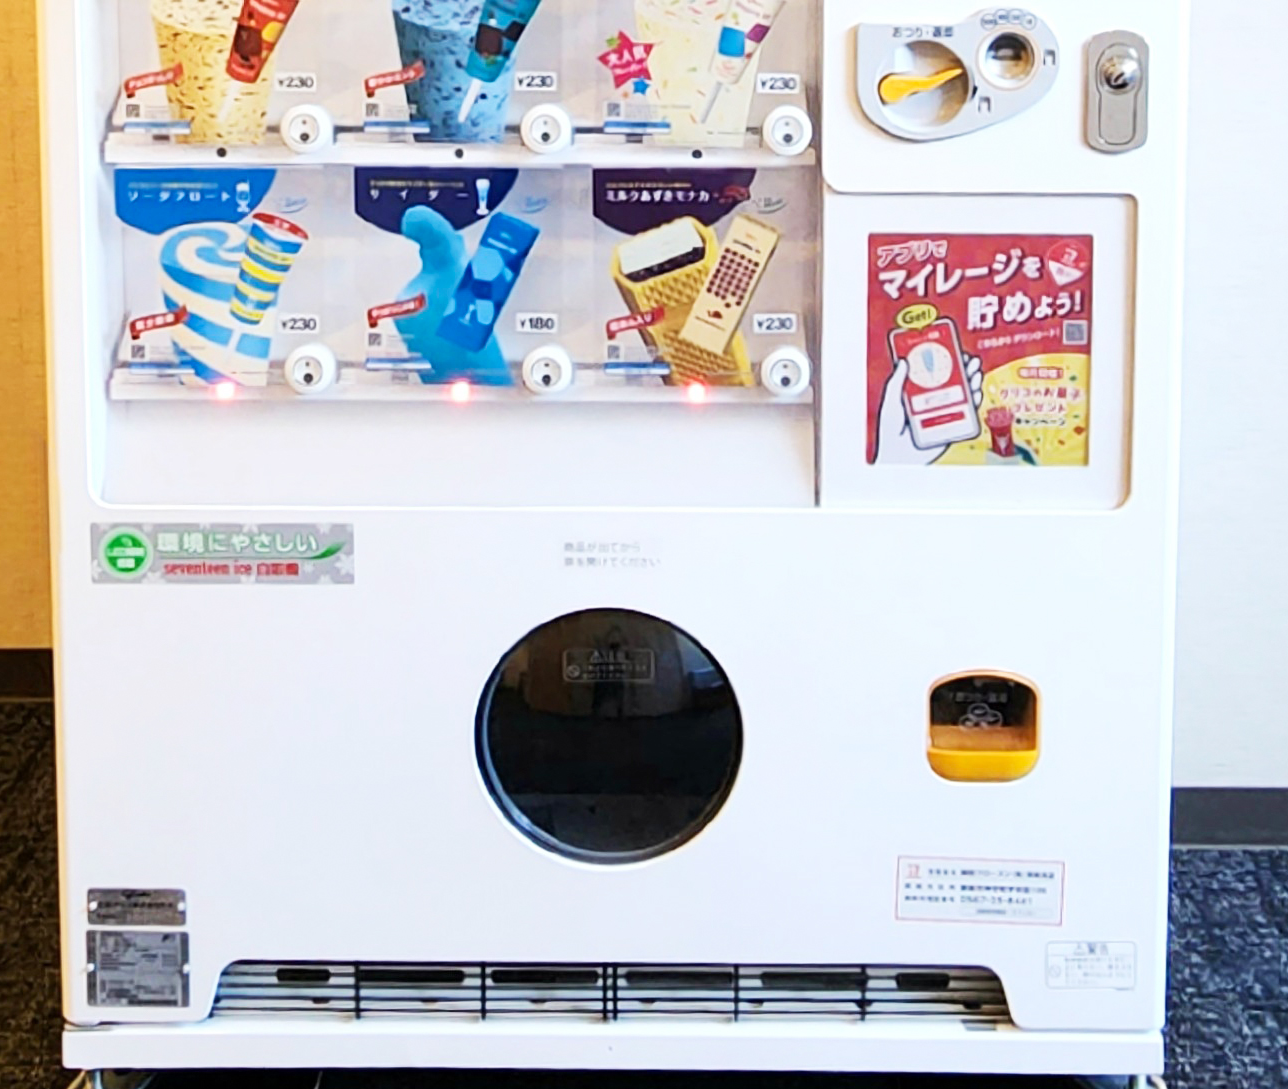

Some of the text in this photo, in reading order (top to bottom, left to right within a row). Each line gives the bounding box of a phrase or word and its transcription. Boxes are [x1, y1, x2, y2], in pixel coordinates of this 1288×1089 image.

[277, 75, 315, 89] ¥230
[517, 75, 554, 88] ¥230
[761, 77, 798, 90] ¥230
[128, 190, 231, 202] ソーダフロート
[606, 190, 710, 203] ミルクあずきモナカ
[878, 248, 1043, 300] マイレージを
[282, 317, 317, 331] ¥230
[757, 317, 794, 331] ¥230
[156, 532, 319, 553] 環境にやさしい
